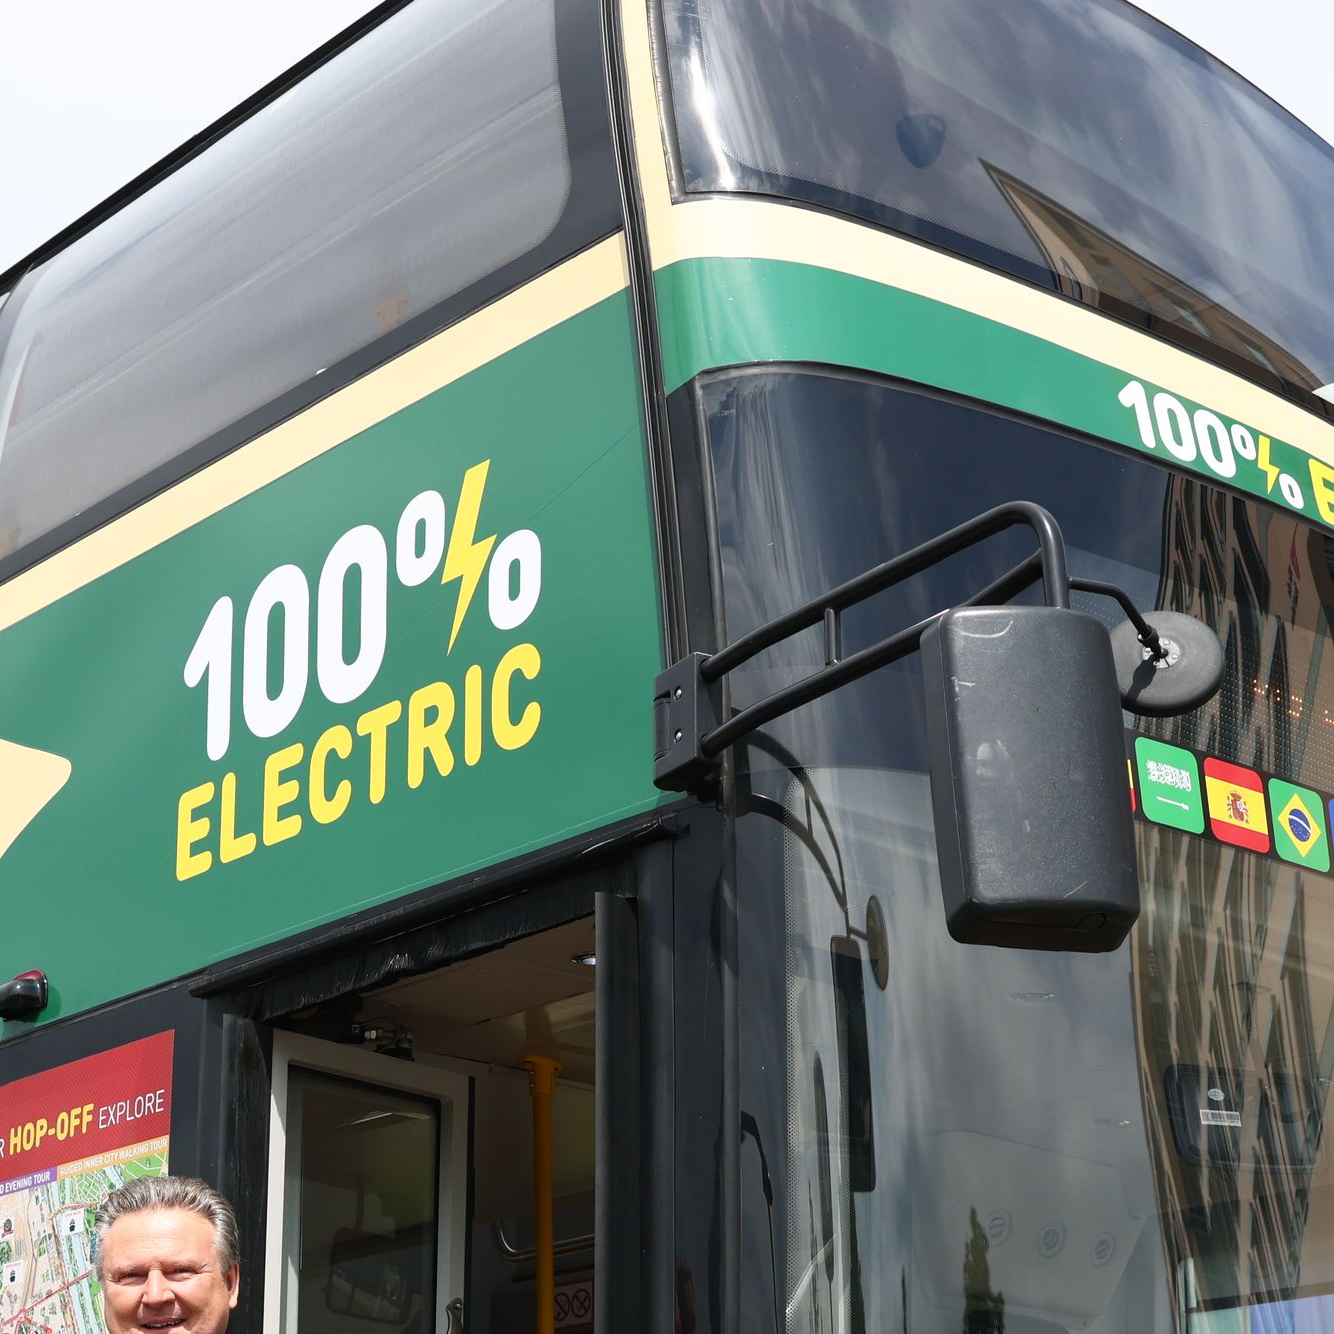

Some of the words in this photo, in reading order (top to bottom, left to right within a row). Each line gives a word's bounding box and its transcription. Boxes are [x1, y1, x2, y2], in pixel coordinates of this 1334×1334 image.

[1117, 380, 1304, 510] 100%
[183, 459, 542, 761] 100%
[176, 643, 542, 881] ELECTRIC
[9, 1103, 95, 1156] HOP-OFF
[98, 1089, 165, 1129] EXPLORE
[59, 1162, 82, 1176] GUIDED
[83, 1158, 104, 1170] INNER
[104, 1153, 117, 1165] CITY
[117, 1144, 149, 1160] WALKING
[150, 1138, 168, 1152] TOUR
[5, 1177, 33, 1196] EVENING
[33, 1171, 50, 1186] TOUR
